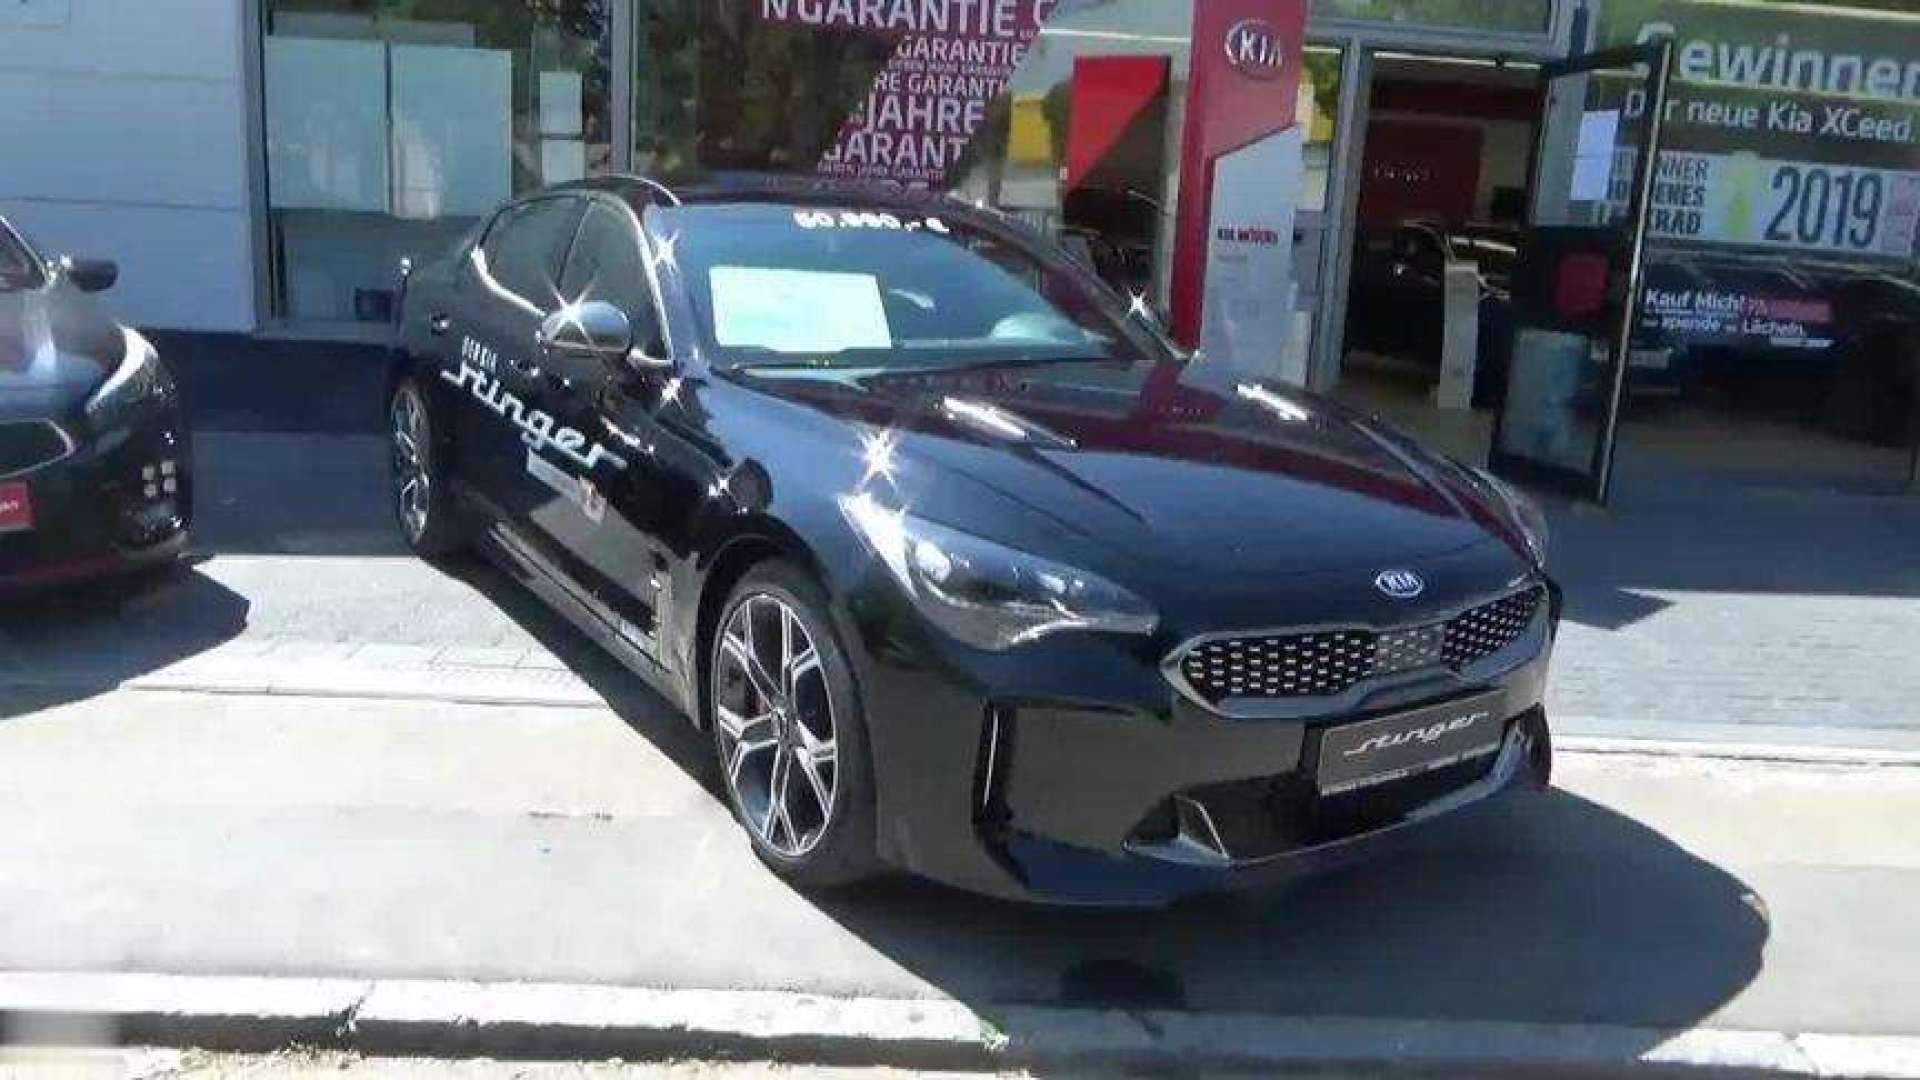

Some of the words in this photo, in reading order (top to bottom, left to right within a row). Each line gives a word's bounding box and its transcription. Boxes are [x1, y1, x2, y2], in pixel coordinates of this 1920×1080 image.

[797, 0, 1017, 37] GARANTIE
[1236, 27, 1285, 70] KIA
[1625, 88, 1681, 121] Dr
[1688, 99, 1759, 129] neue
[1767, 102, 1813, 134] Kia
[1763, 165, 1885, 249] 2019
[1646, 288, 1692, 308] Kauf
